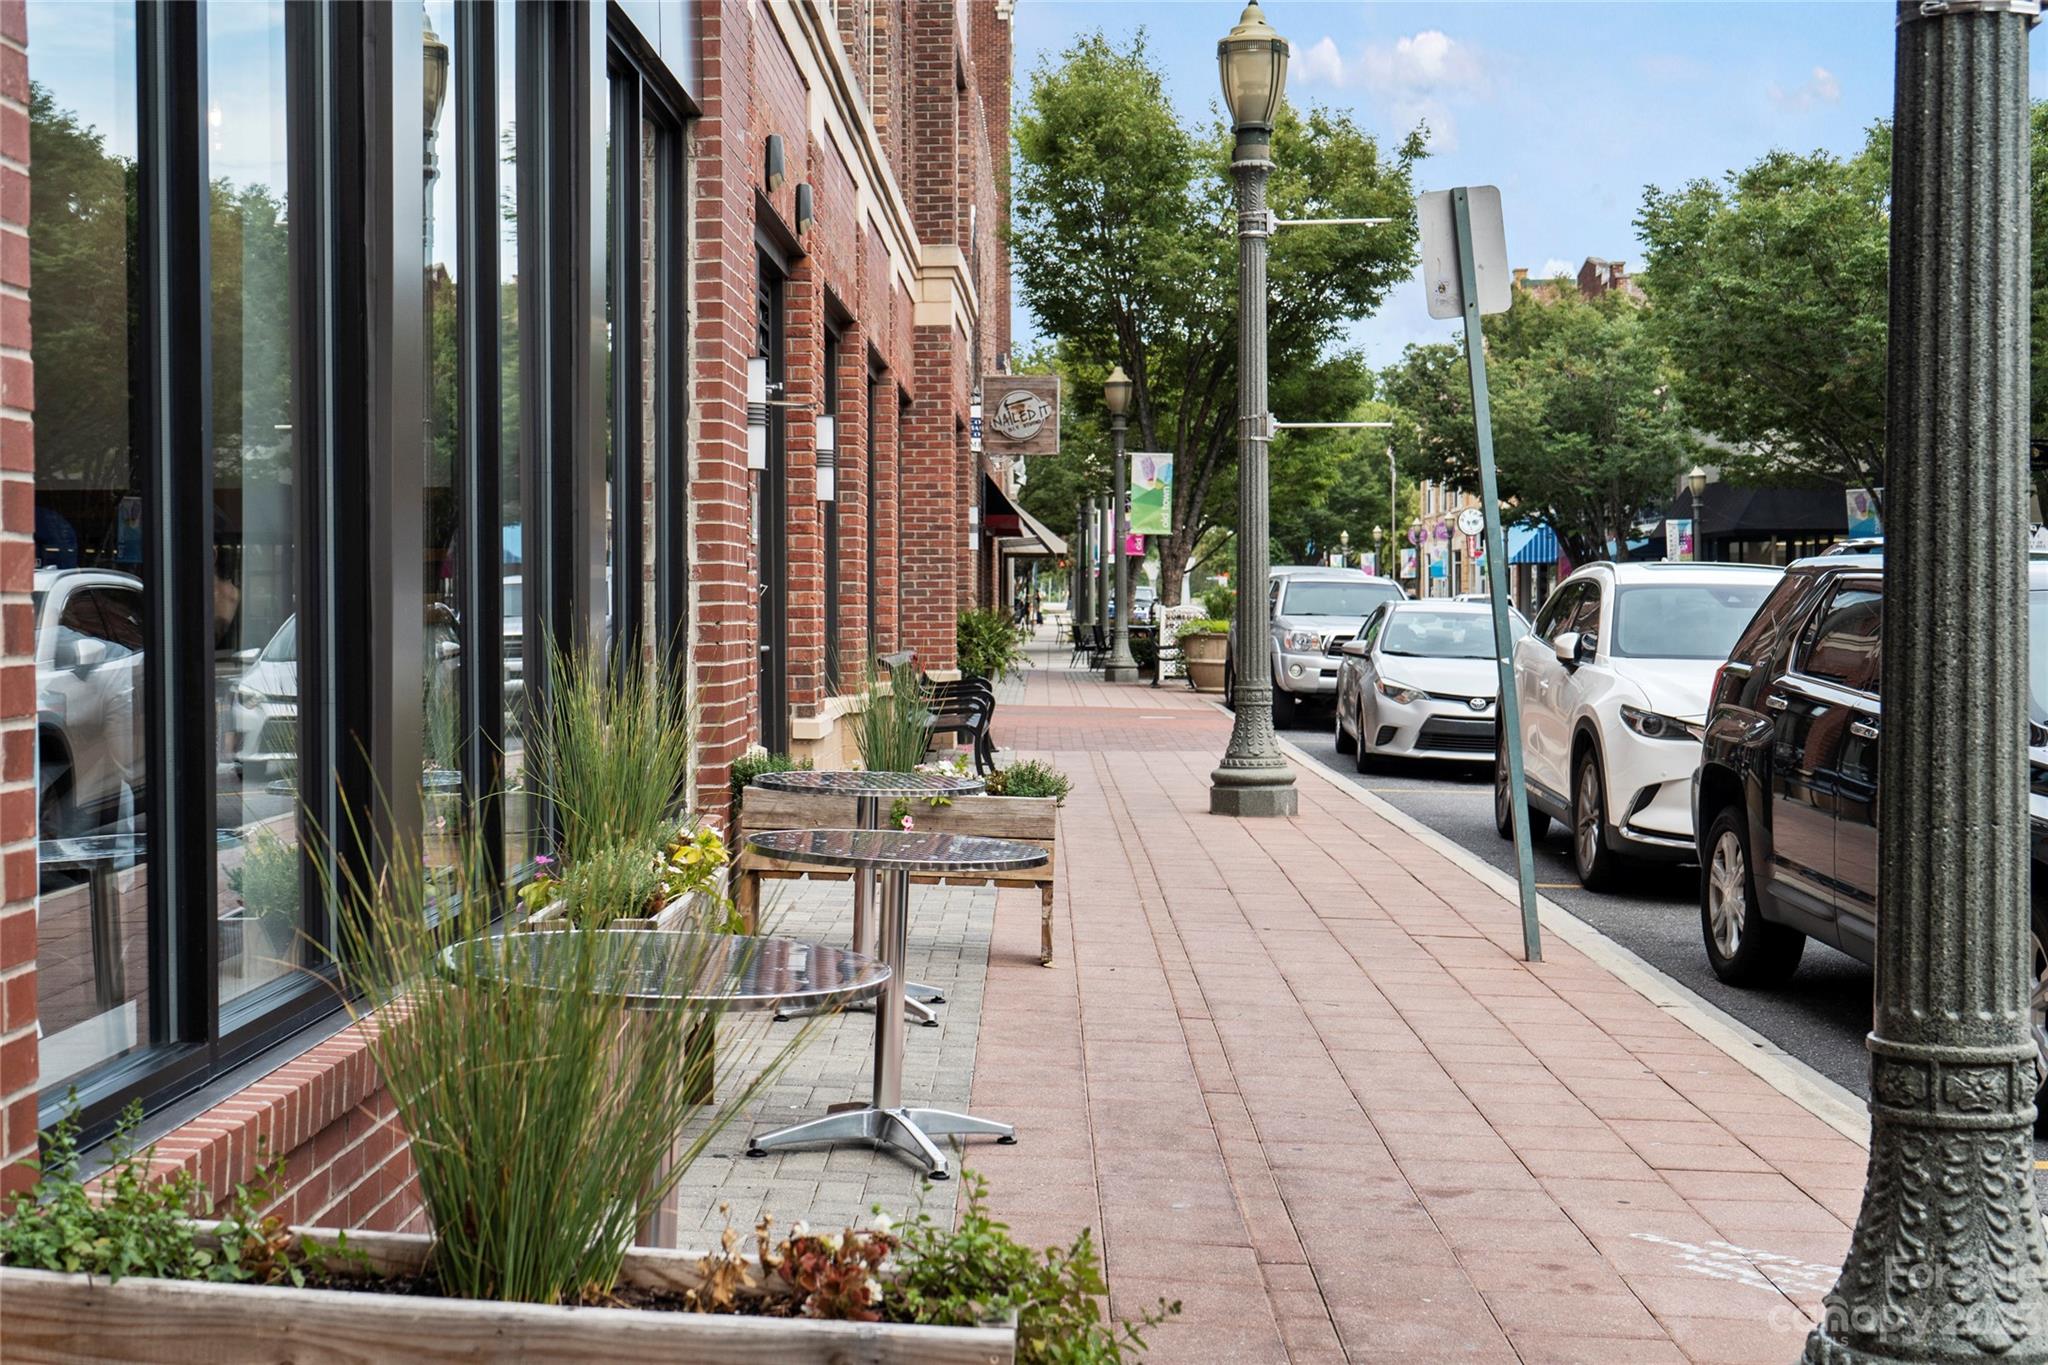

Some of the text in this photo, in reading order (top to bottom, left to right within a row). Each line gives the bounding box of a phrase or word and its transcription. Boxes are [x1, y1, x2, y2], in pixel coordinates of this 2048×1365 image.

[993, 408, 1036, 428] NAILED
[1039, 404, 1049, 418] IT
[1160, 512, 1169, 528] old
